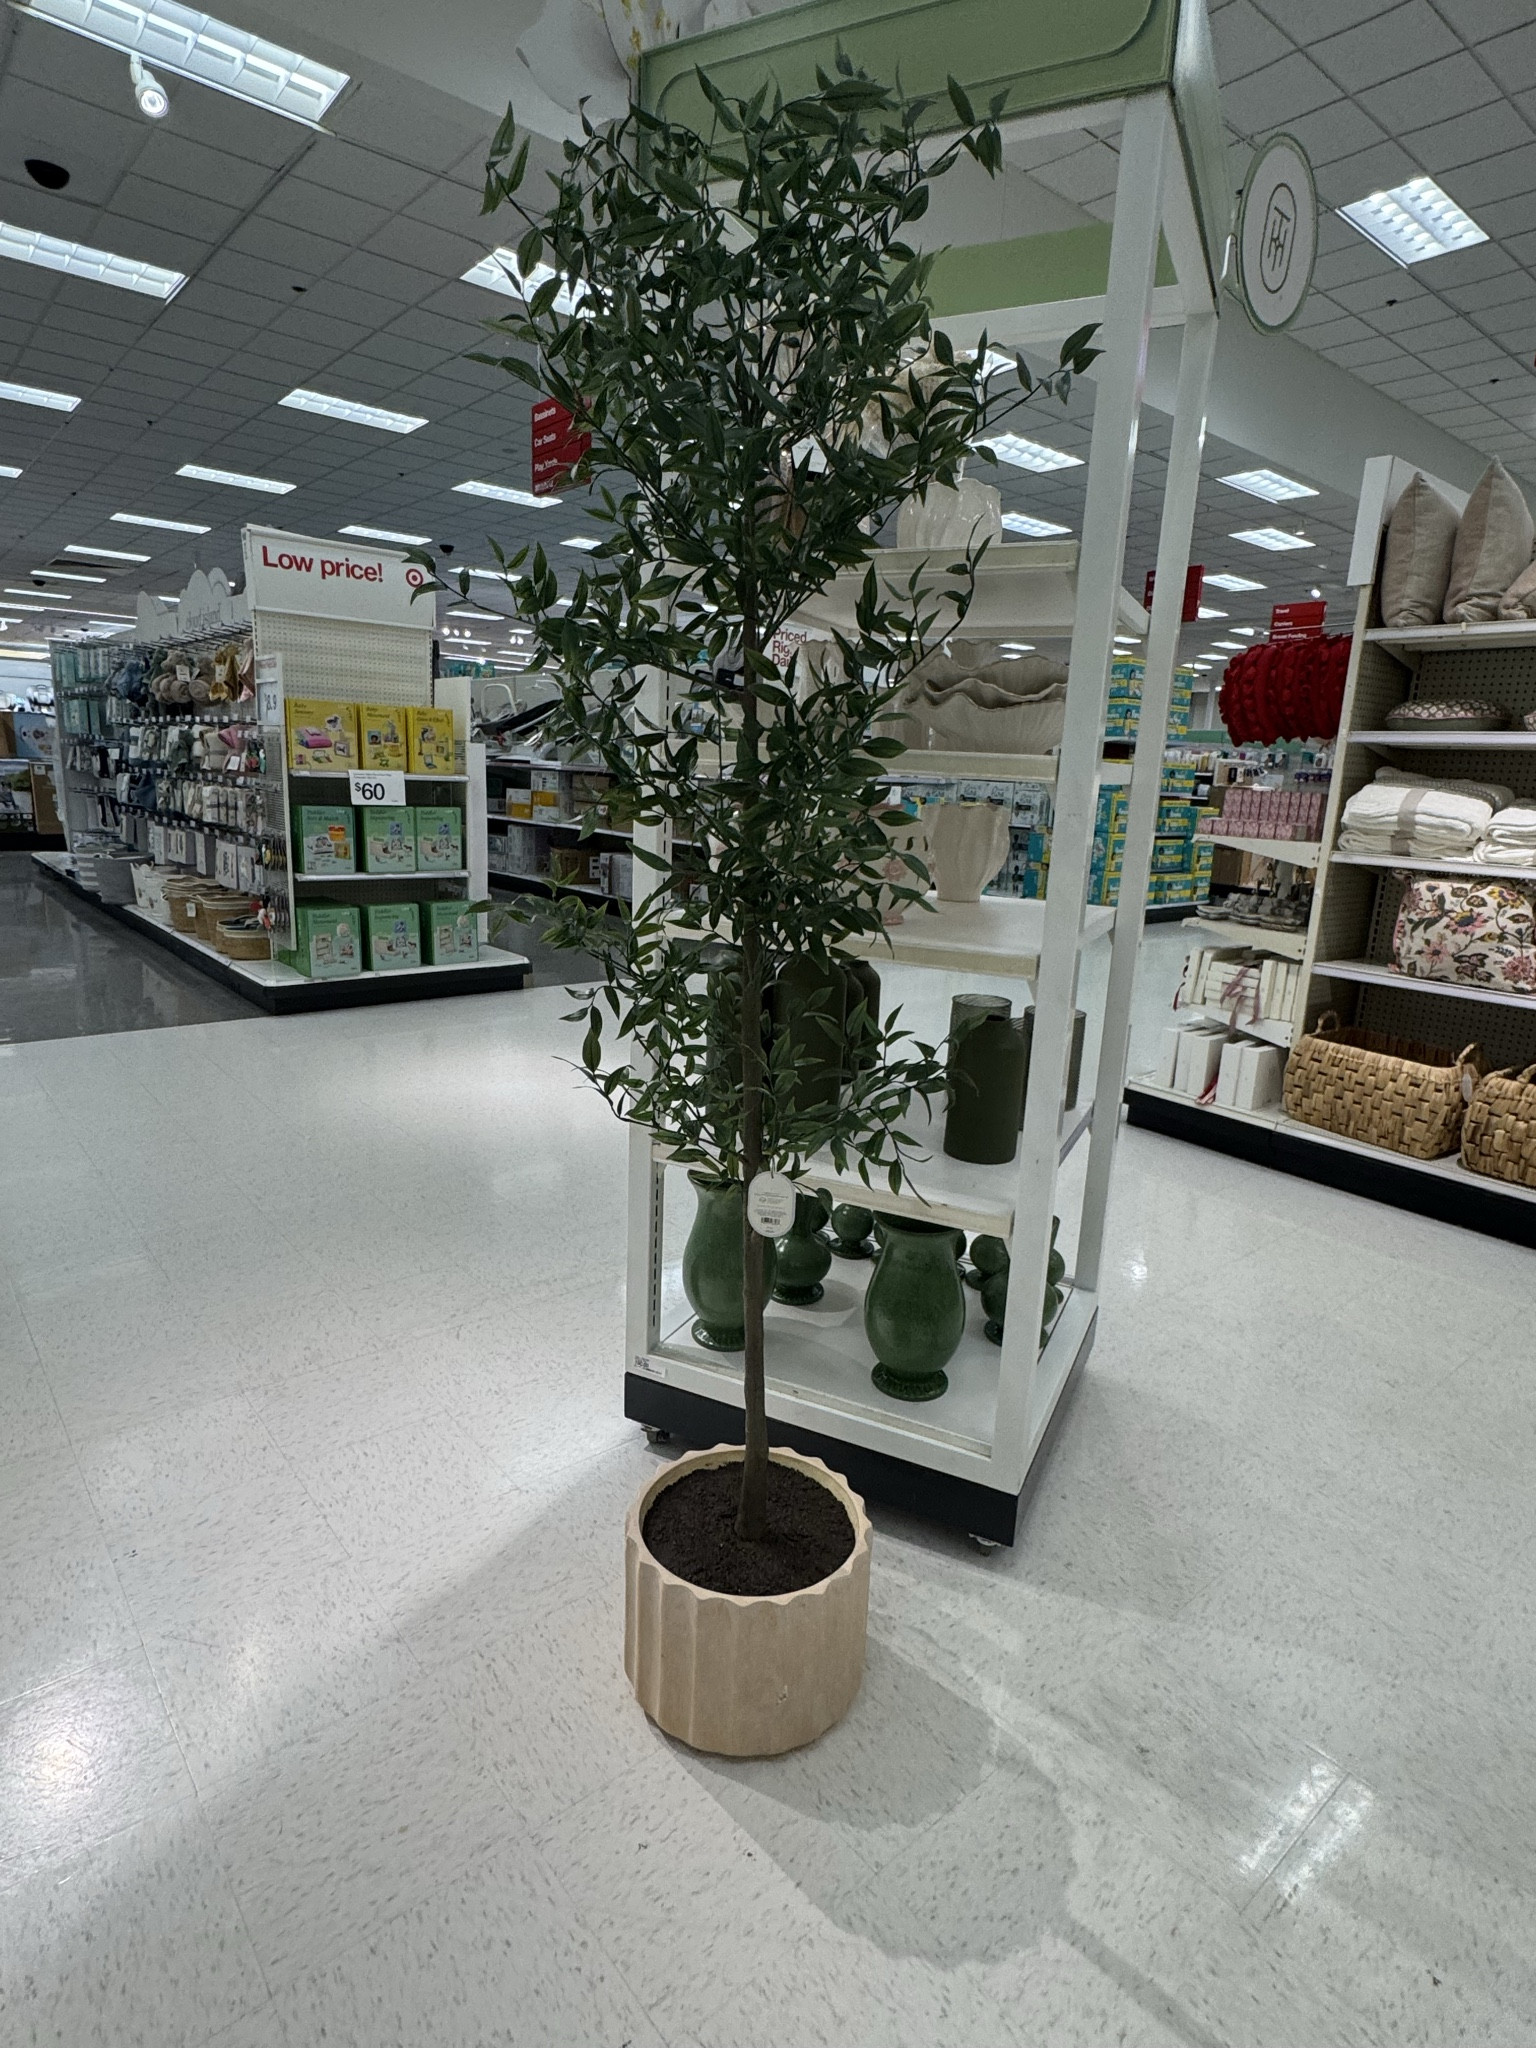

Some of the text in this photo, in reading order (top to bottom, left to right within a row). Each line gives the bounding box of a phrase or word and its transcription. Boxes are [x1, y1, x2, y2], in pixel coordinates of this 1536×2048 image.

[262, 545, 384, 583] Low price!
[773, 628, 807, 644] Priced
[772, 640, 793, 657] Rig
[354, 781, 386, 801] $60
